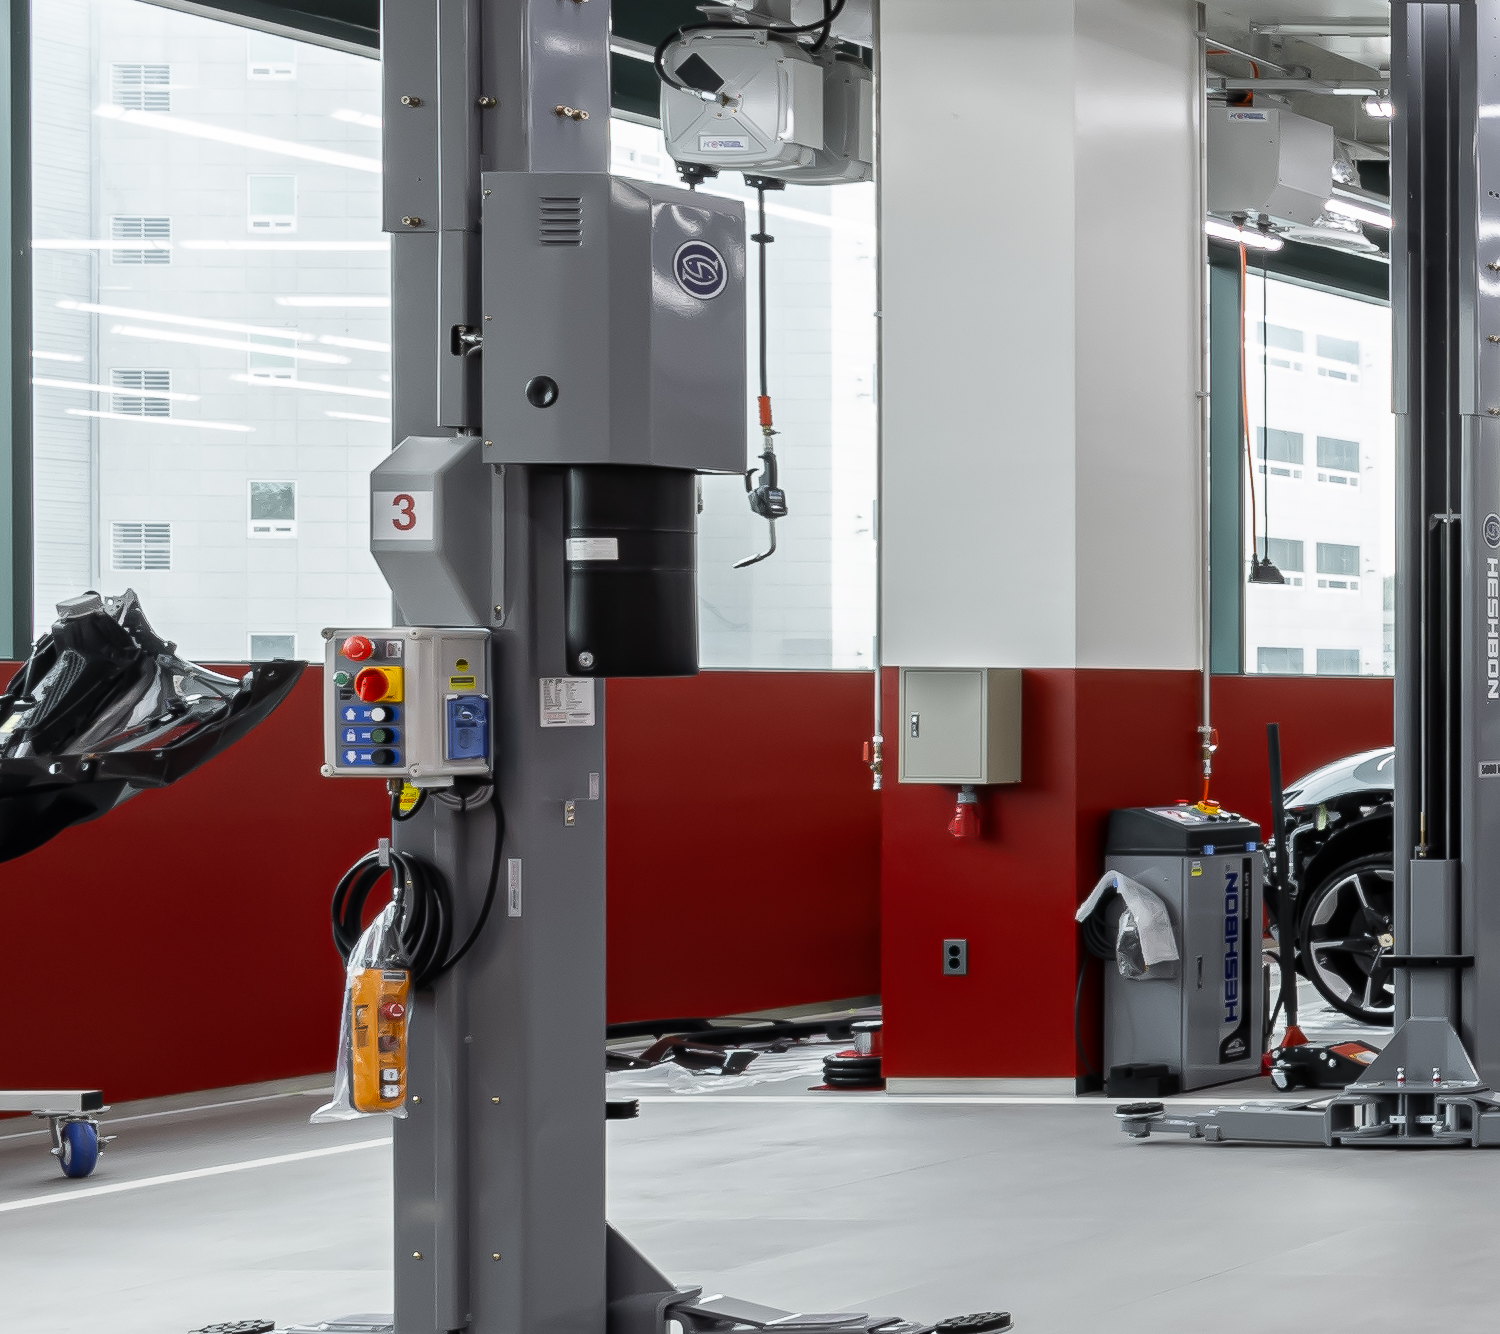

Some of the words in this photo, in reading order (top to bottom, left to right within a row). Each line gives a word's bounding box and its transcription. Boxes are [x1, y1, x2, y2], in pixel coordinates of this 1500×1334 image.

[392, 494, 417, 531] 3
[1487, 557, 1500, 699] HESHBON
[1225, 872, 1238, 1023] HESHBON
